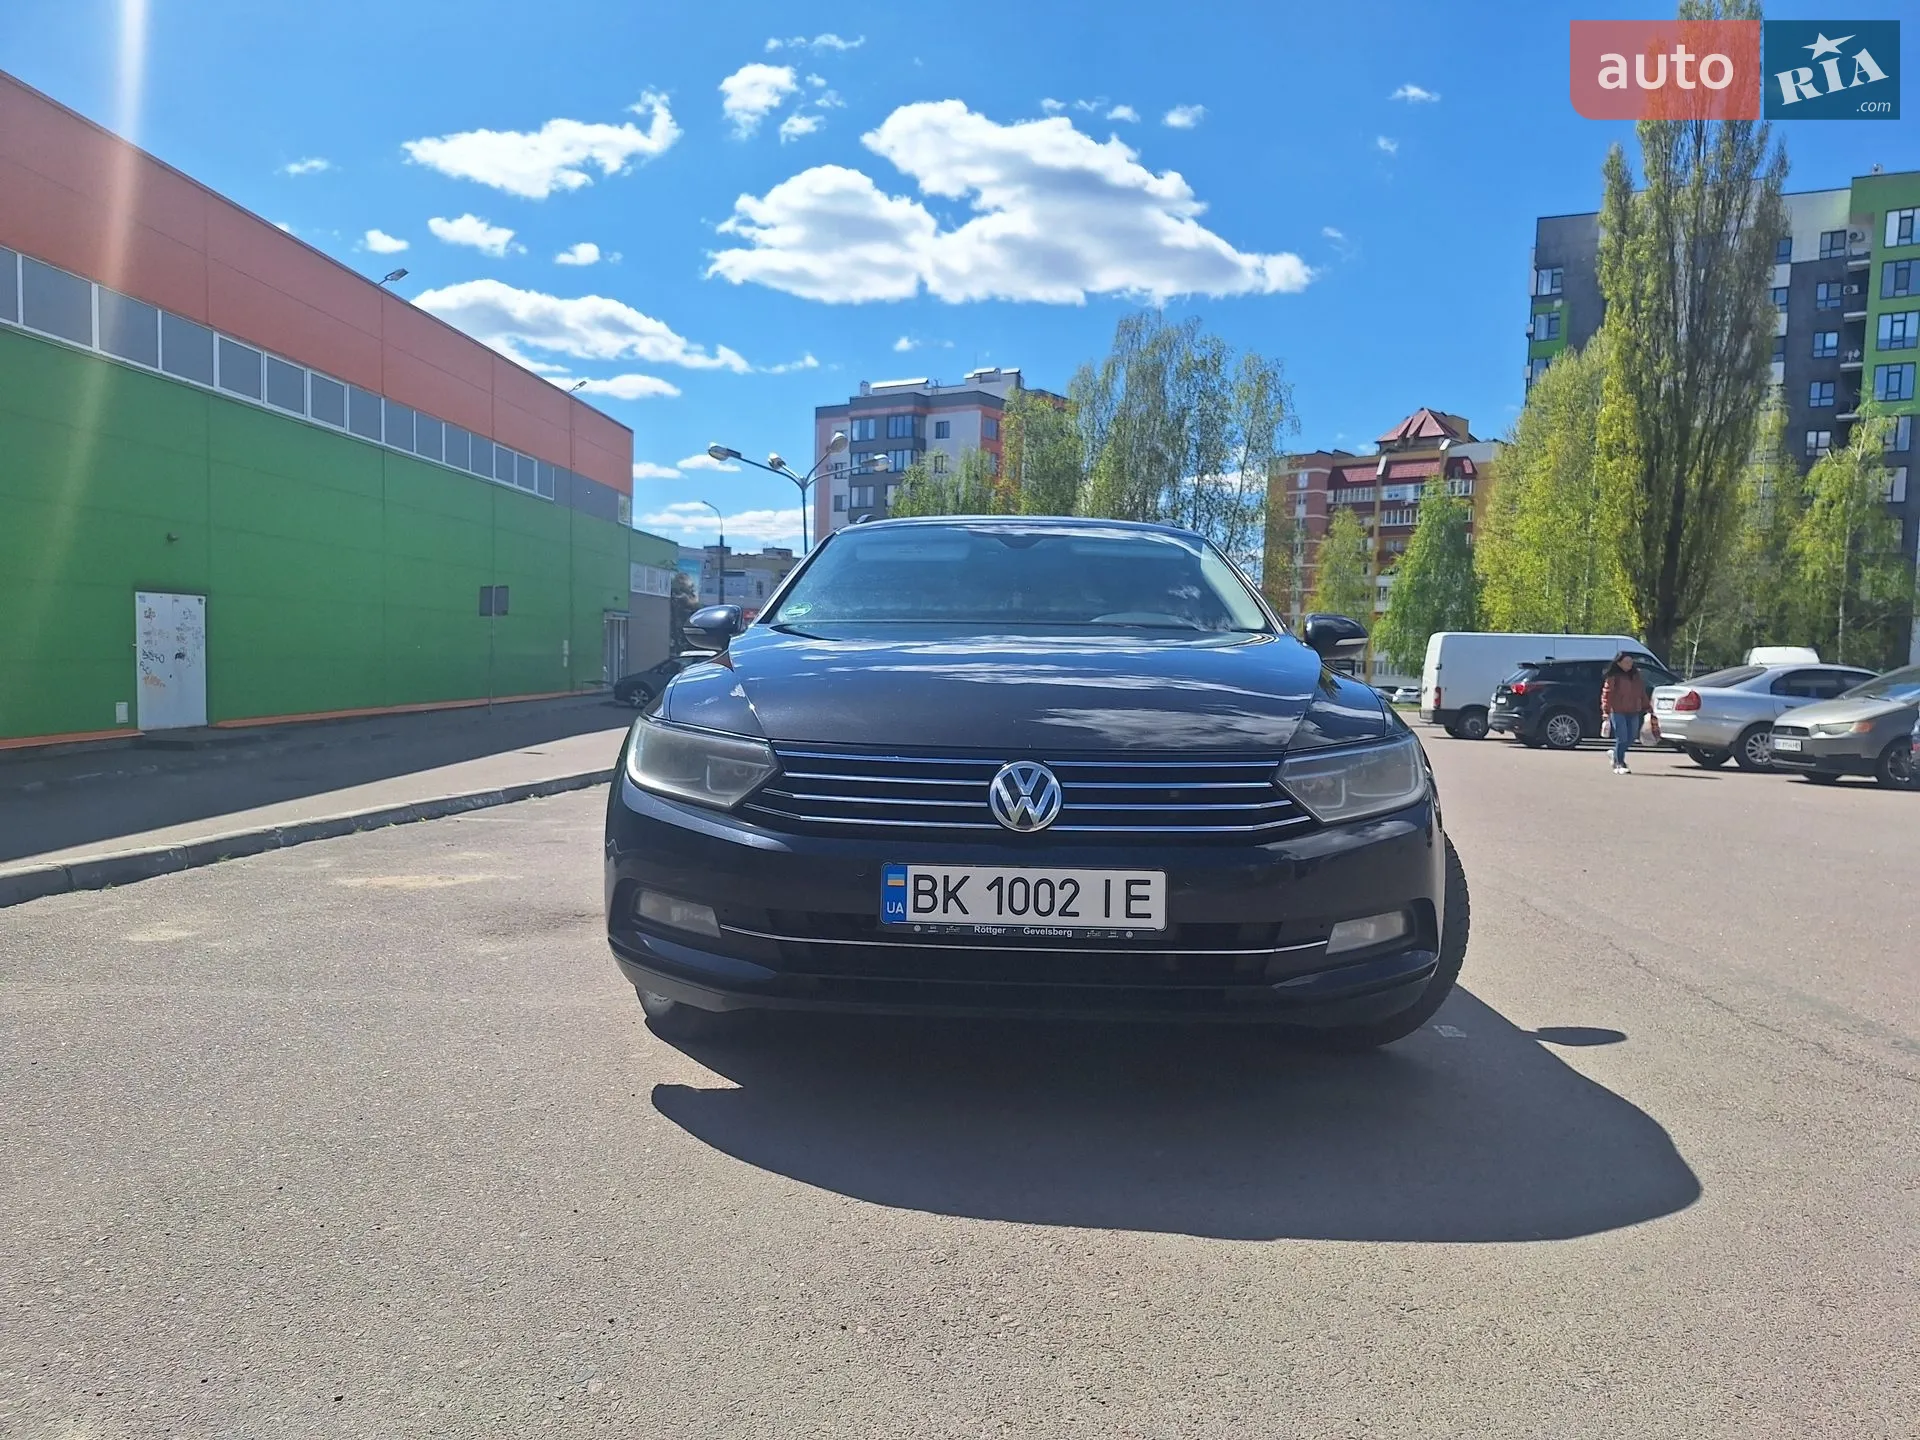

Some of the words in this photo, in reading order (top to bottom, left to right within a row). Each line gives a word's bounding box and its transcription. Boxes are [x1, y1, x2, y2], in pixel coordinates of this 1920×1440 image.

[912, 873, 971, 915] BK
[986, 876, 1080, 918] 1002
[886, 901, 904, 914] UA
[974, 925, 1007, 935] Röttger
[1023, 927, 1073, 938] Gevelsberg
